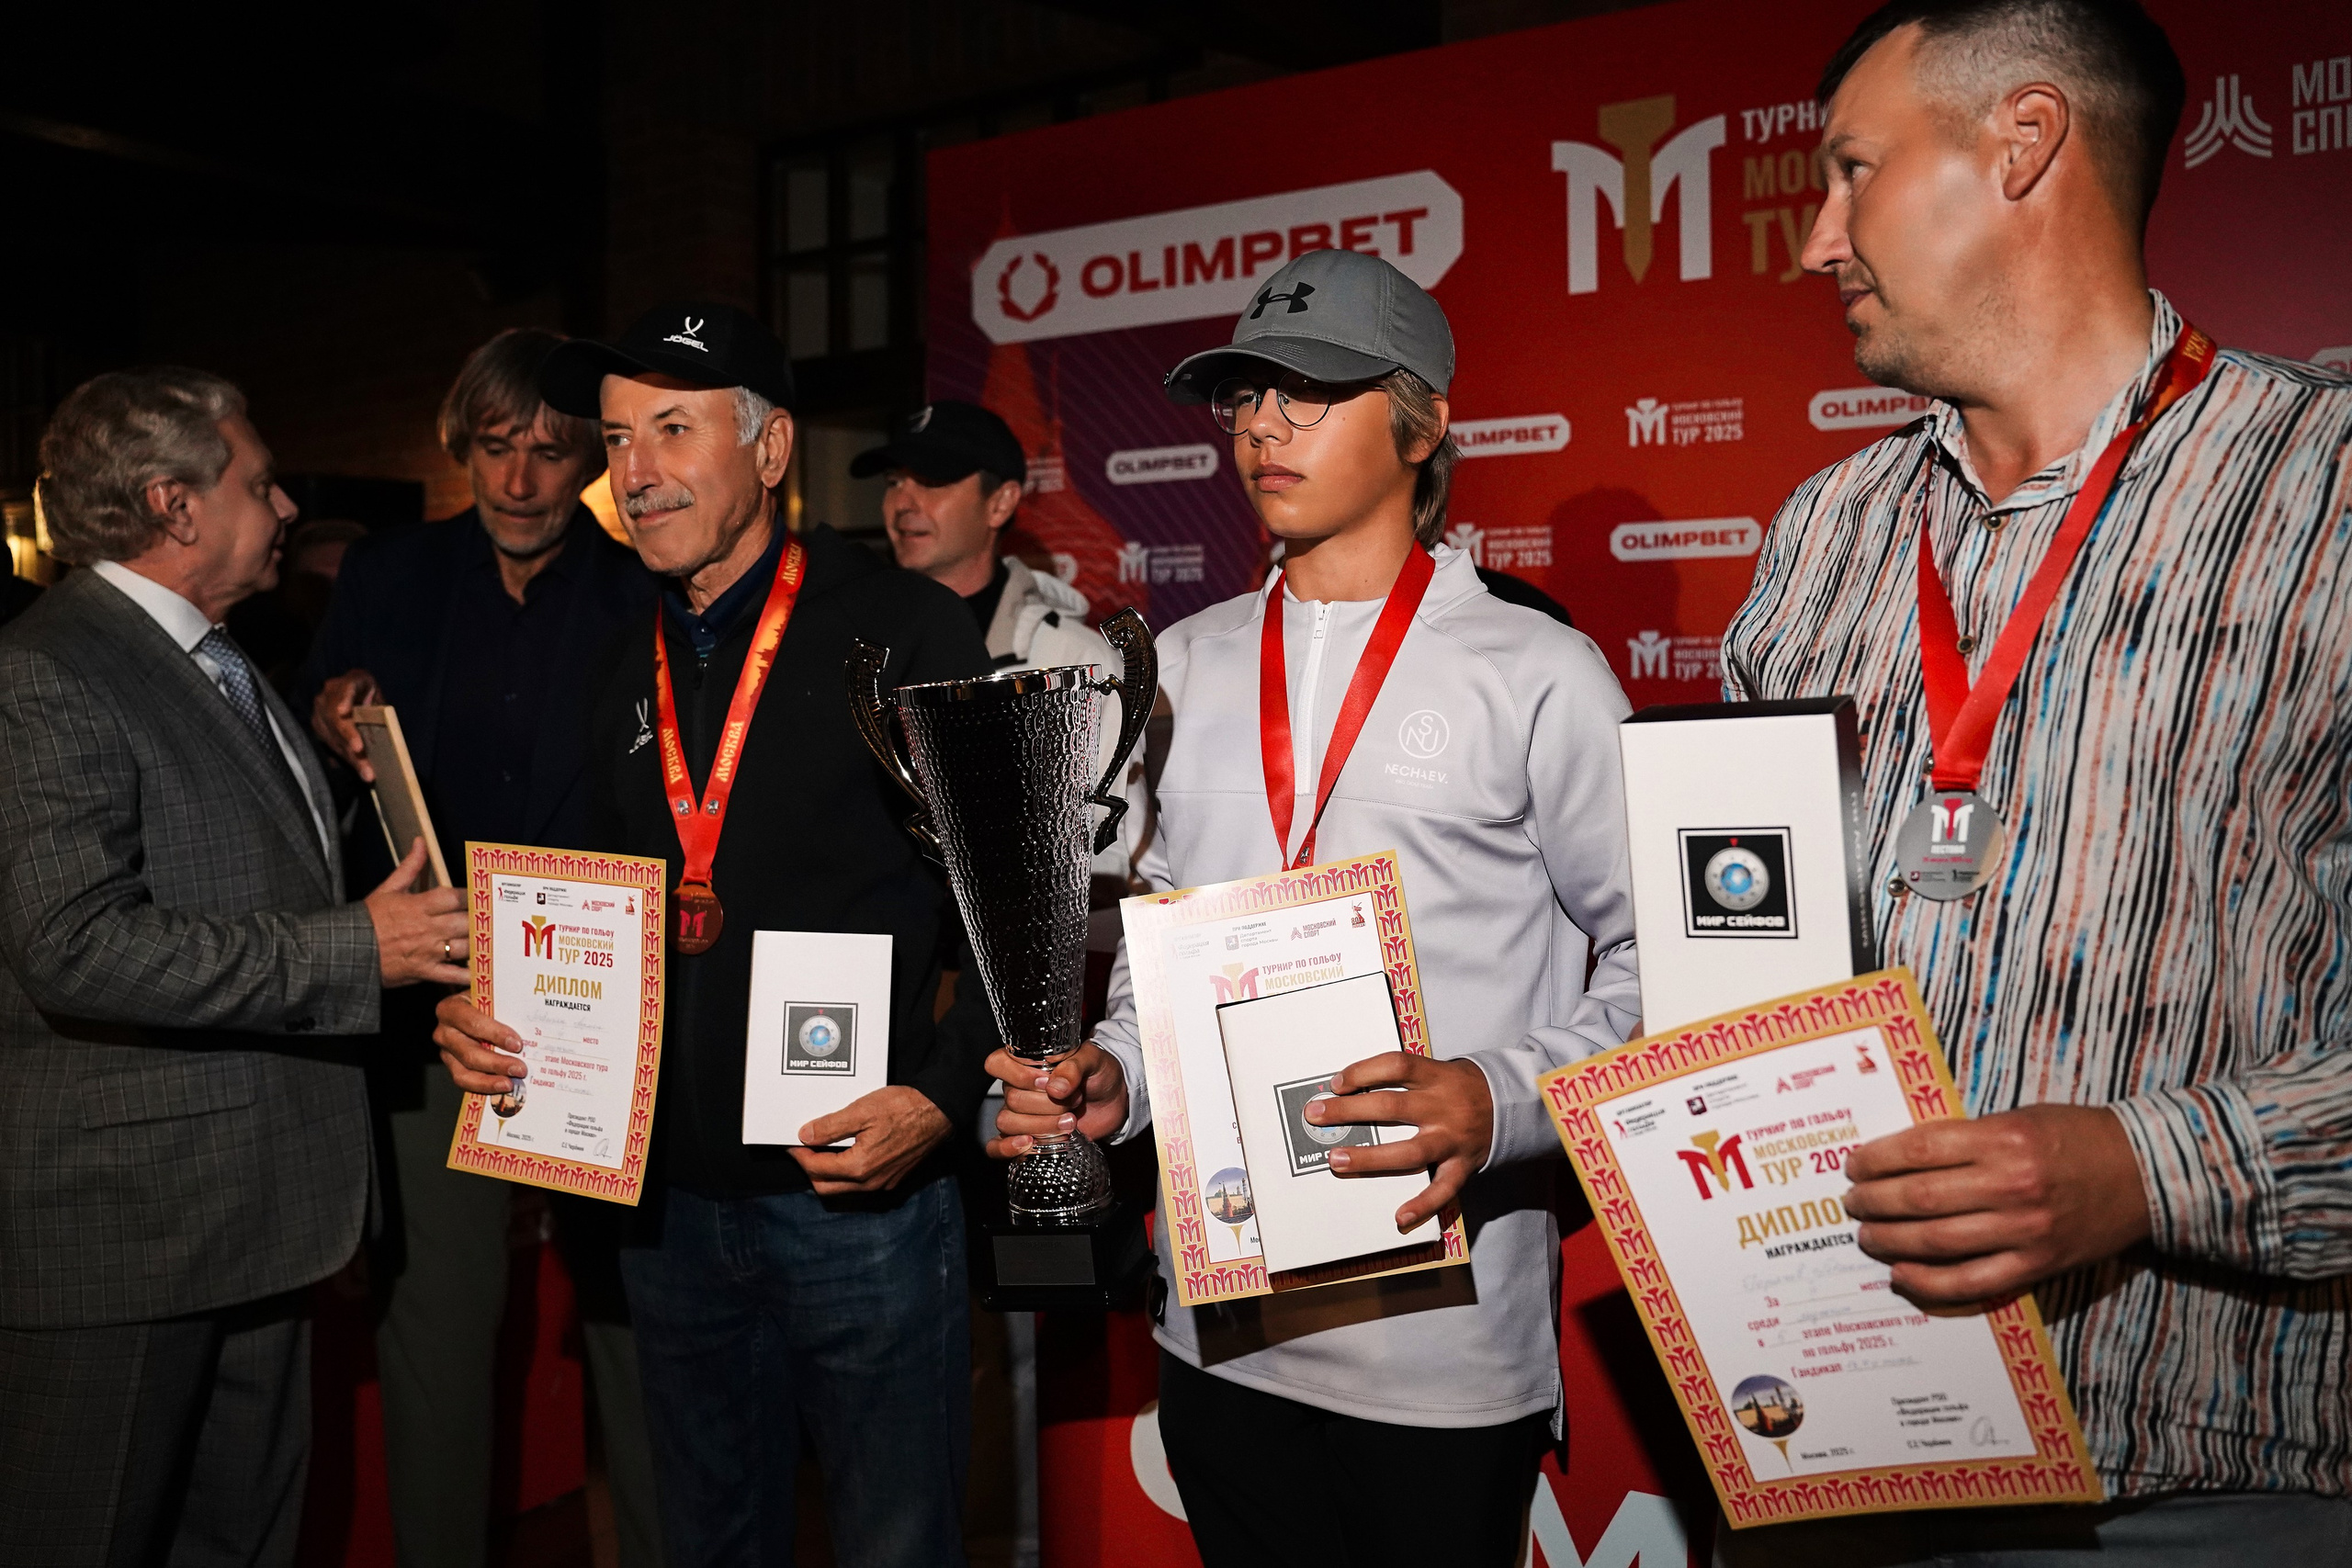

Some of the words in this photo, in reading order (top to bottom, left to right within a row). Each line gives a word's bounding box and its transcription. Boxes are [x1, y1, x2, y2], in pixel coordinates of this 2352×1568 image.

[1080, 208, 1429, 299] OLIMPBET
[1820, 395, 1928, 419] OLIMPB
[1704, 423, 1744, 443] 2025
[1621, 528, 1750, 551] OLIMPBET
[662, 728, 684, 784] МОСКВА
[717, 720, 745, 783] МОСКВА
[1241, 921, 1267, 931] ПОДДЕРЖКЕ
[1303, 918, 1337, 931] МОСКОВСКИЙ
[1696, 915, 1725, 927] МИР
[1726, 913, 1786, 928] СЕЙФОВ
[559, 924, 580, 933] ТУРНИР
[582, 927, 590, 935] ПО
[591, 928, 615, 938] ГОЛЬФУ
[1239, 929, 1272, 939] Департамент
[1304, 930, 1320, 938] СПОРТ
[559, 935, 614, 951] МОСКОВСКИЙ
[559, 947, 580, 964] ТУР
[583, 950, 614, 968] 2025
[1262, 961, 1293, 975] ТУРНИР
[1295, 959, 1306, 968] ПО
[1308, 953, 1341, 965] ГОЛЬФУ
[1265, 963, 1344, 990] МОСКОВСКИЙ
[534, 974, 602, 999] ДИПЛОМ
[545, 998, 591, 1011] НАГРАЖДАЕТСЯ
[535, 1027, 542, 1036] За
[582, 1037, 599, 1045] место
[545, 1055, 560, 1064] этапе
[560, 1056, 595, 1070] Московского
[596, 1064, 608, 1073] тура
[809, 1059, 848, 1068] СЕЙФОВ
[540, 1066, 548, 1075] по
[548, 1068, 567, 1078] гольфу
[568, 1070, 582, 1080] 2025
[530, 1076, 555, 1089] Гандикап
[1747, 1122, 1786, 1140] ТУРНИР
[1789, 1118, 1805, 1130] ПО
[1807, 1108, 1852, 1124] ГОЛЬФУ
[1753, 1122, 1860, 1159] МОСКОВСКИЙ
[1299, 1152, 1322, 1165] МИР
[1760, 1156, 1803, 1185] ТУР
[1736, 1195, 1853, 1249] ДИПЛО
[1765, 1232, 1854, 1259] НАГРАЖДАЕТСЯ
[1764, 1296, 1780, 1308] За
[1747, 1316, 1780, 1332] среди
[1833, 1317, 1902, 1334] Московского
[1817, 1341, 1855, 1357] гольфу
[1857, 1334, 1887, 1350] 2025
[1791, 1363, 1842, 1379] Гандикап
